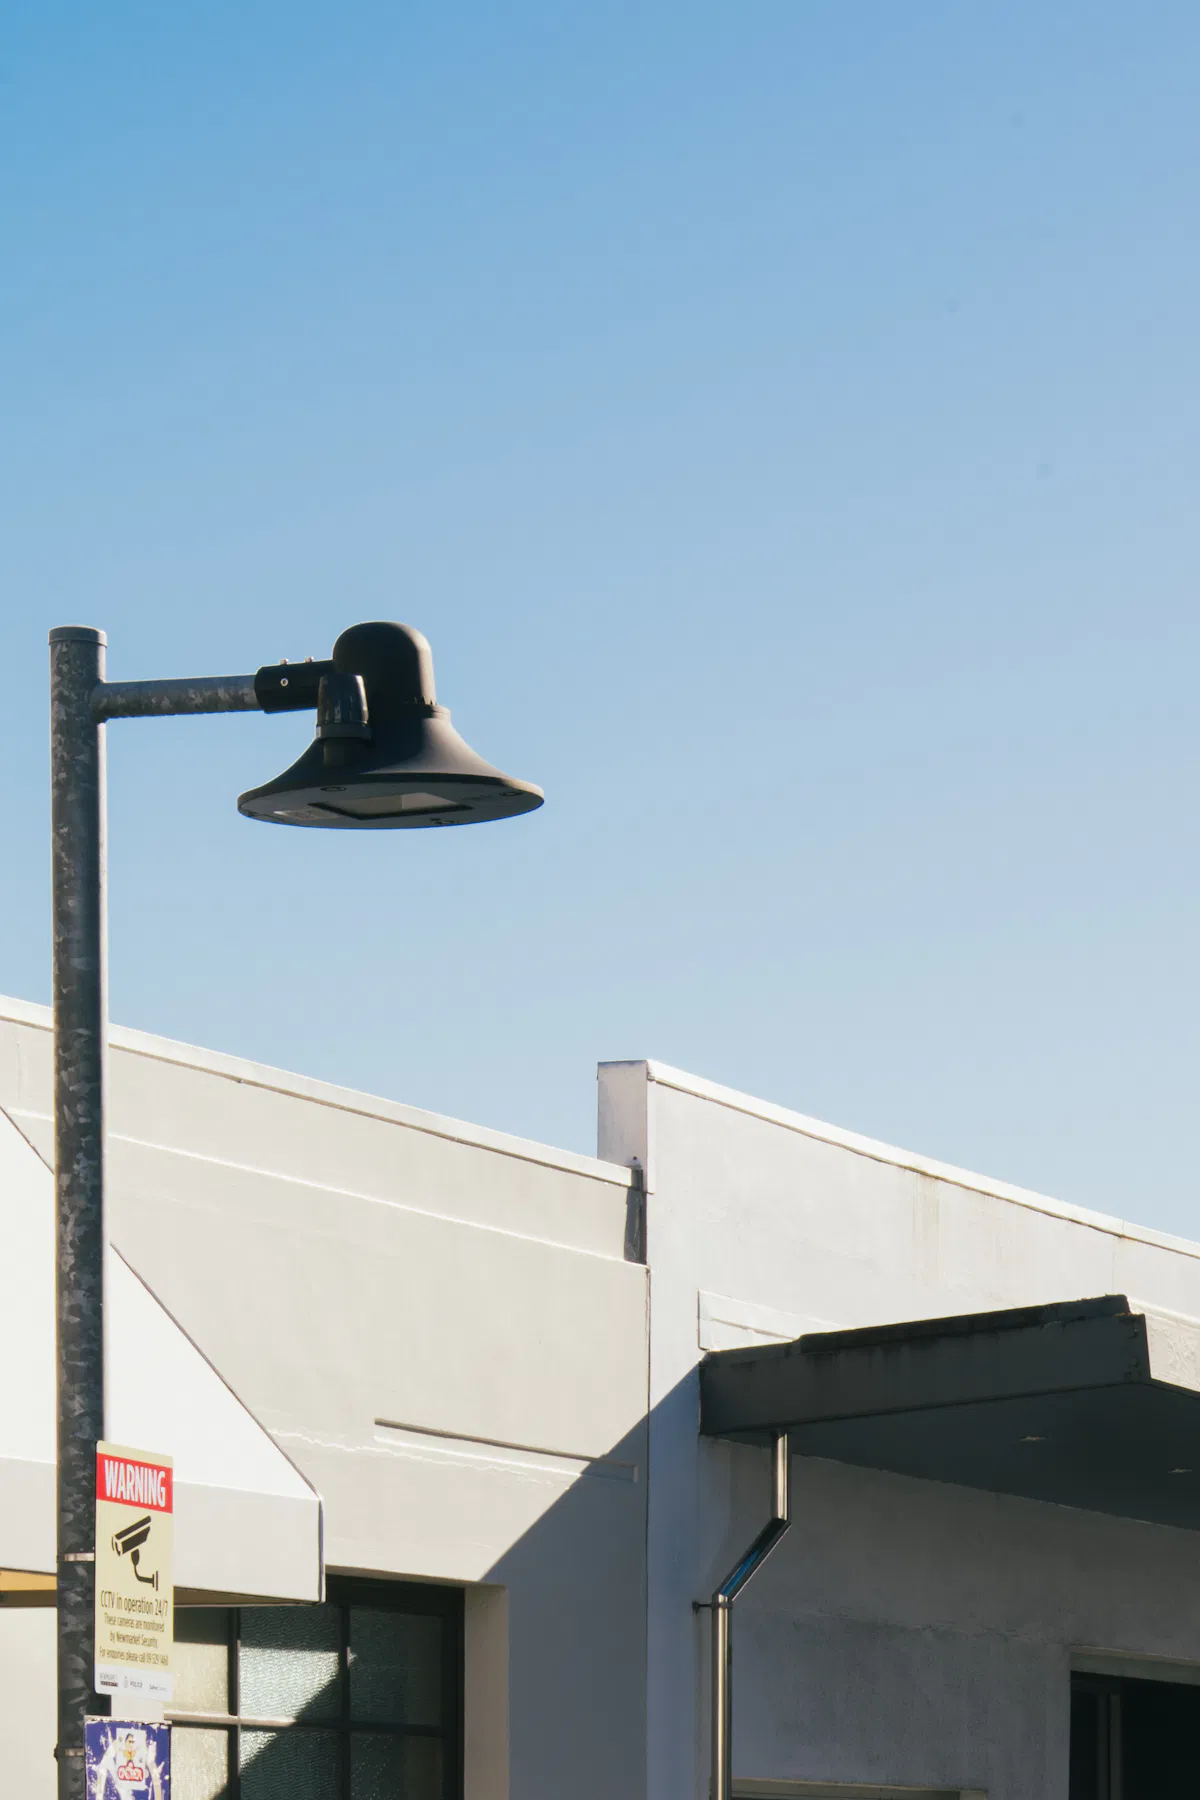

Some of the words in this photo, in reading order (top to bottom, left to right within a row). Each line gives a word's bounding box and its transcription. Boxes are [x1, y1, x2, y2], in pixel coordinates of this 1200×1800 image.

[104, 1459, 166, 1508] WARNING
[100, 1590, 115, 1608] CCTV
[116, 1593, 122, 1610] in
[124, 1596, 153, 1613] operation
[155, 1598, 169, 1617] 24/7
